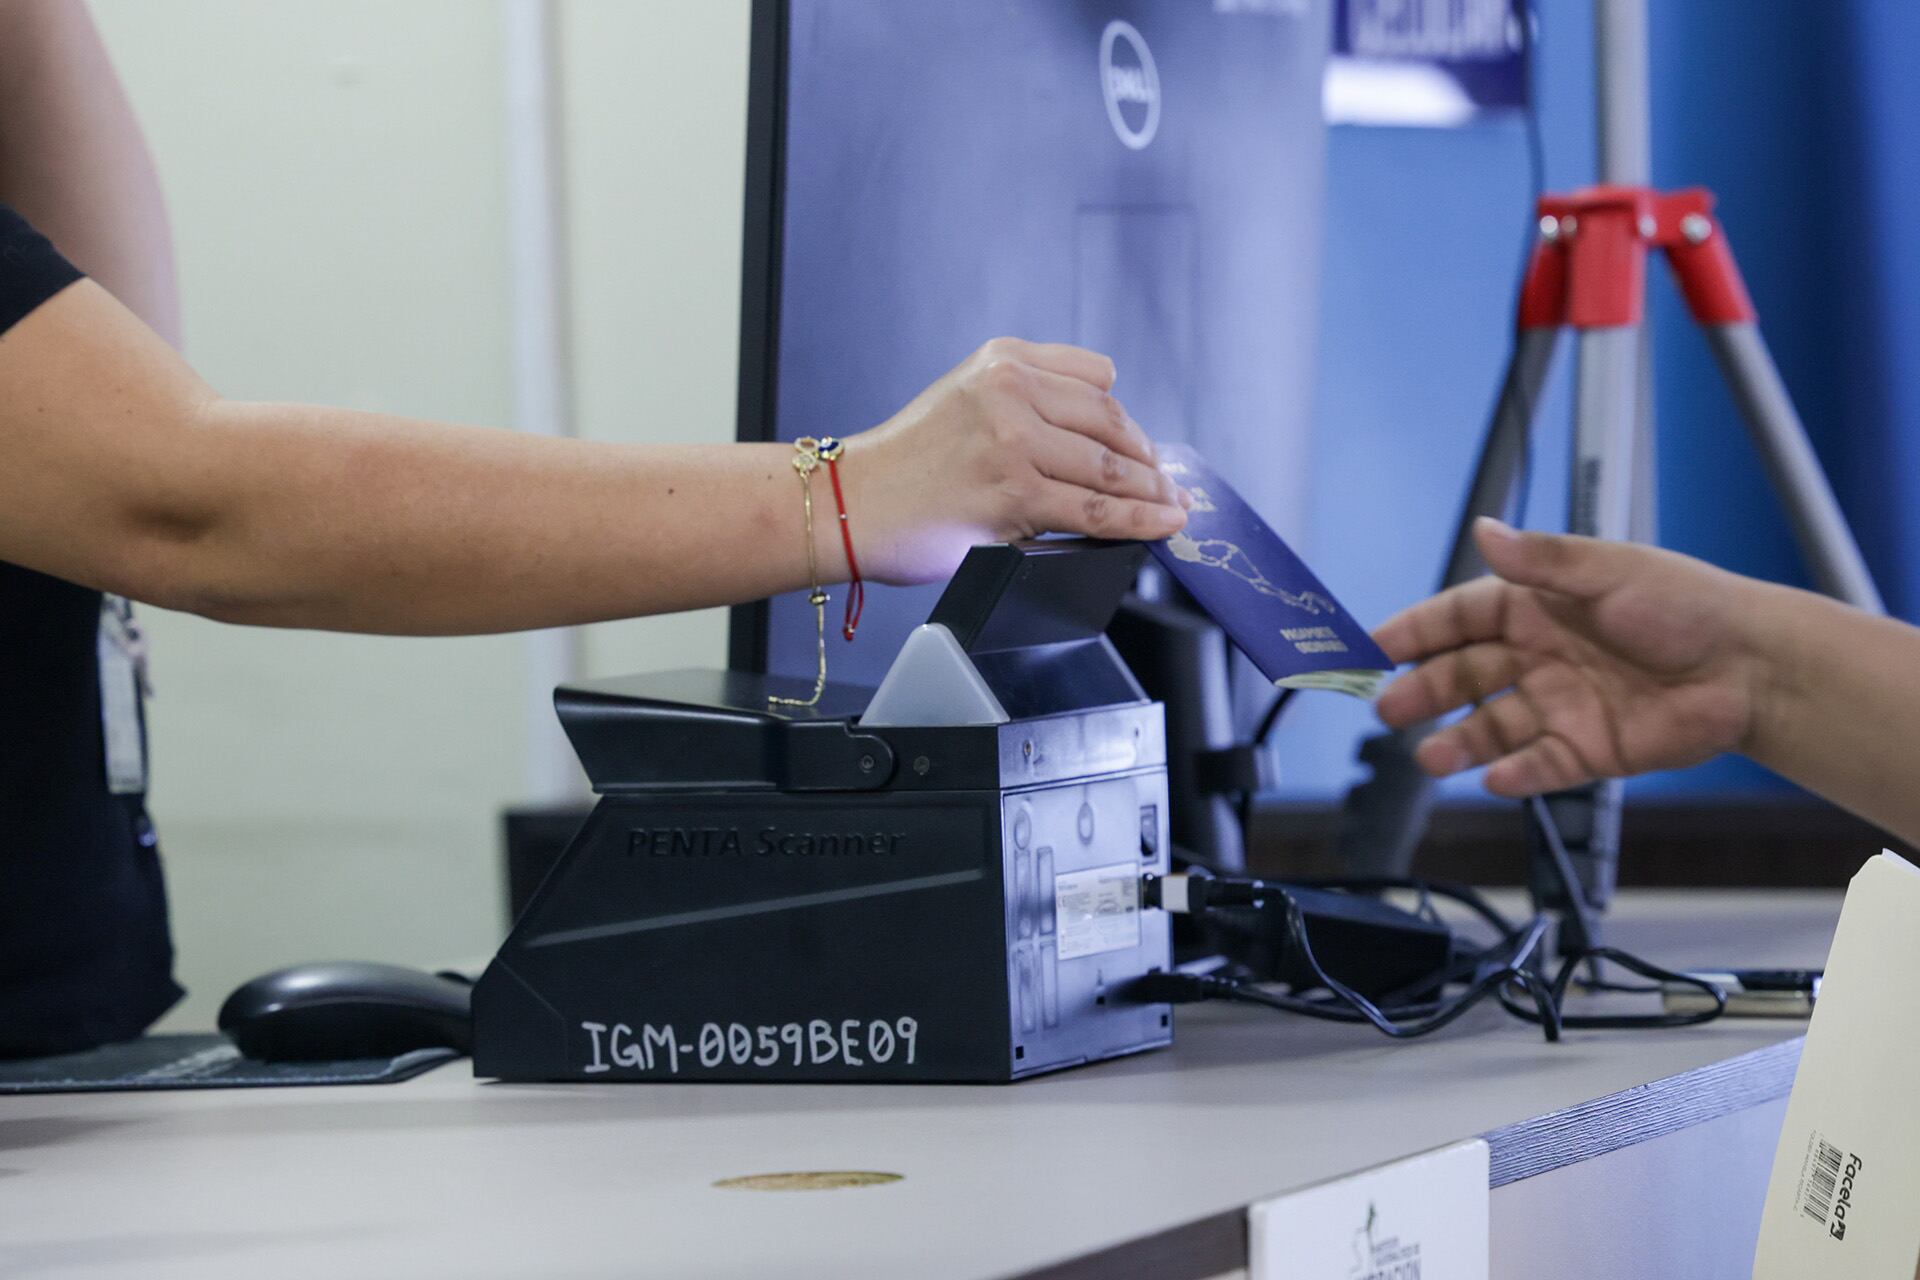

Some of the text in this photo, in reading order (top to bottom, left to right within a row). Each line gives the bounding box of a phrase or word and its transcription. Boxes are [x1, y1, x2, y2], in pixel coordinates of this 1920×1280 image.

[627, 825, 907, 858] PENTA Scanner
[580, 1015, 919, 1074] IGM-0059BE09
